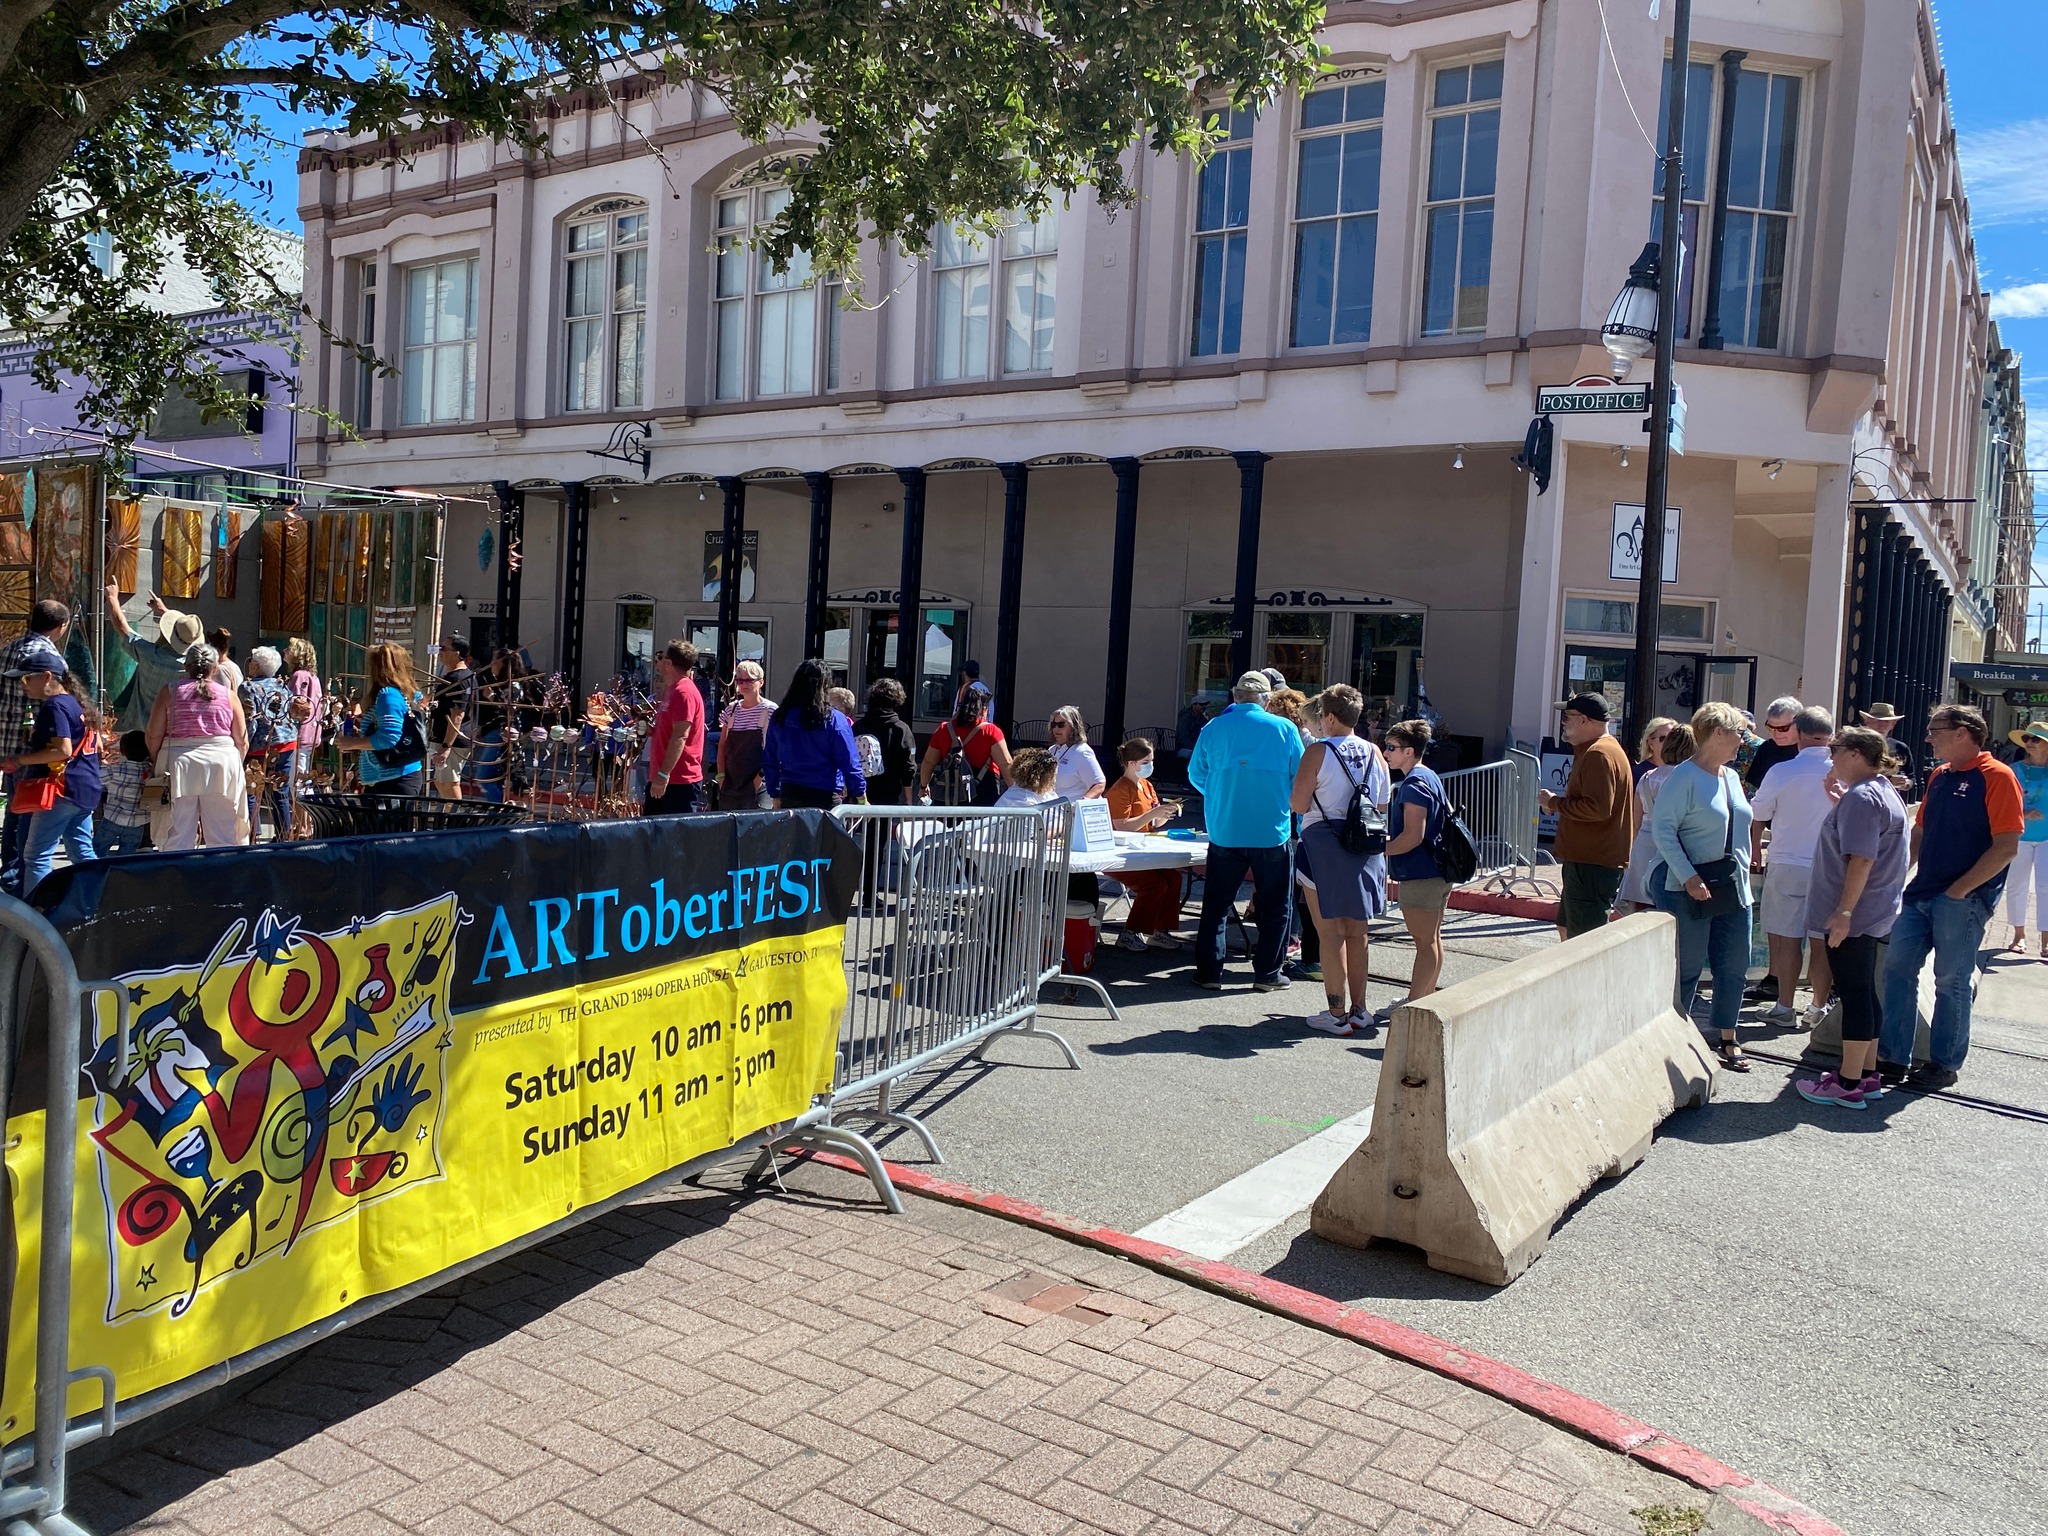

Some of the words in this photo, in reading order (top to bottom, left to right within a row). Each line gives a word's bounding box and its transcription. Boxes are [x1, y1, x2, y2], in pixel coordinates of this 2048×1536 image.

[1541, 393, 1643, 410] POSTOFFICE
[742, 533, 757, 545] tez
[478, 603, 498, 613] 222
[1973, 670, 2015, 680] Breakfast
[472, 858, 832, 984] ARToberFEST
[474, 1014, 534, 1052] presented
[538, 1012, 552, 1034] by
[558, 1006, 579, 1024] TH
[581, 992, 629, 1016] GRAND
[632, 986, 653, 1004] 1894
[655, 978, 691, 998] OPERA
[693, 967, 730, 988] HOUSE
[505, 1046, 636, 1110] Saturday
[651, 1025, 679, 1061] 10
[686, 1019, 721, 1051] am
[740, 1003, 750, 1034] 6
[756, 999, 793, 1036] pm
[523, 1102, 631, 1164] Sunday
[638, 1084, 663, 1120] 11
[674, 1073, 708, 1107] am
[747, 1048, 776, 1088] pm
